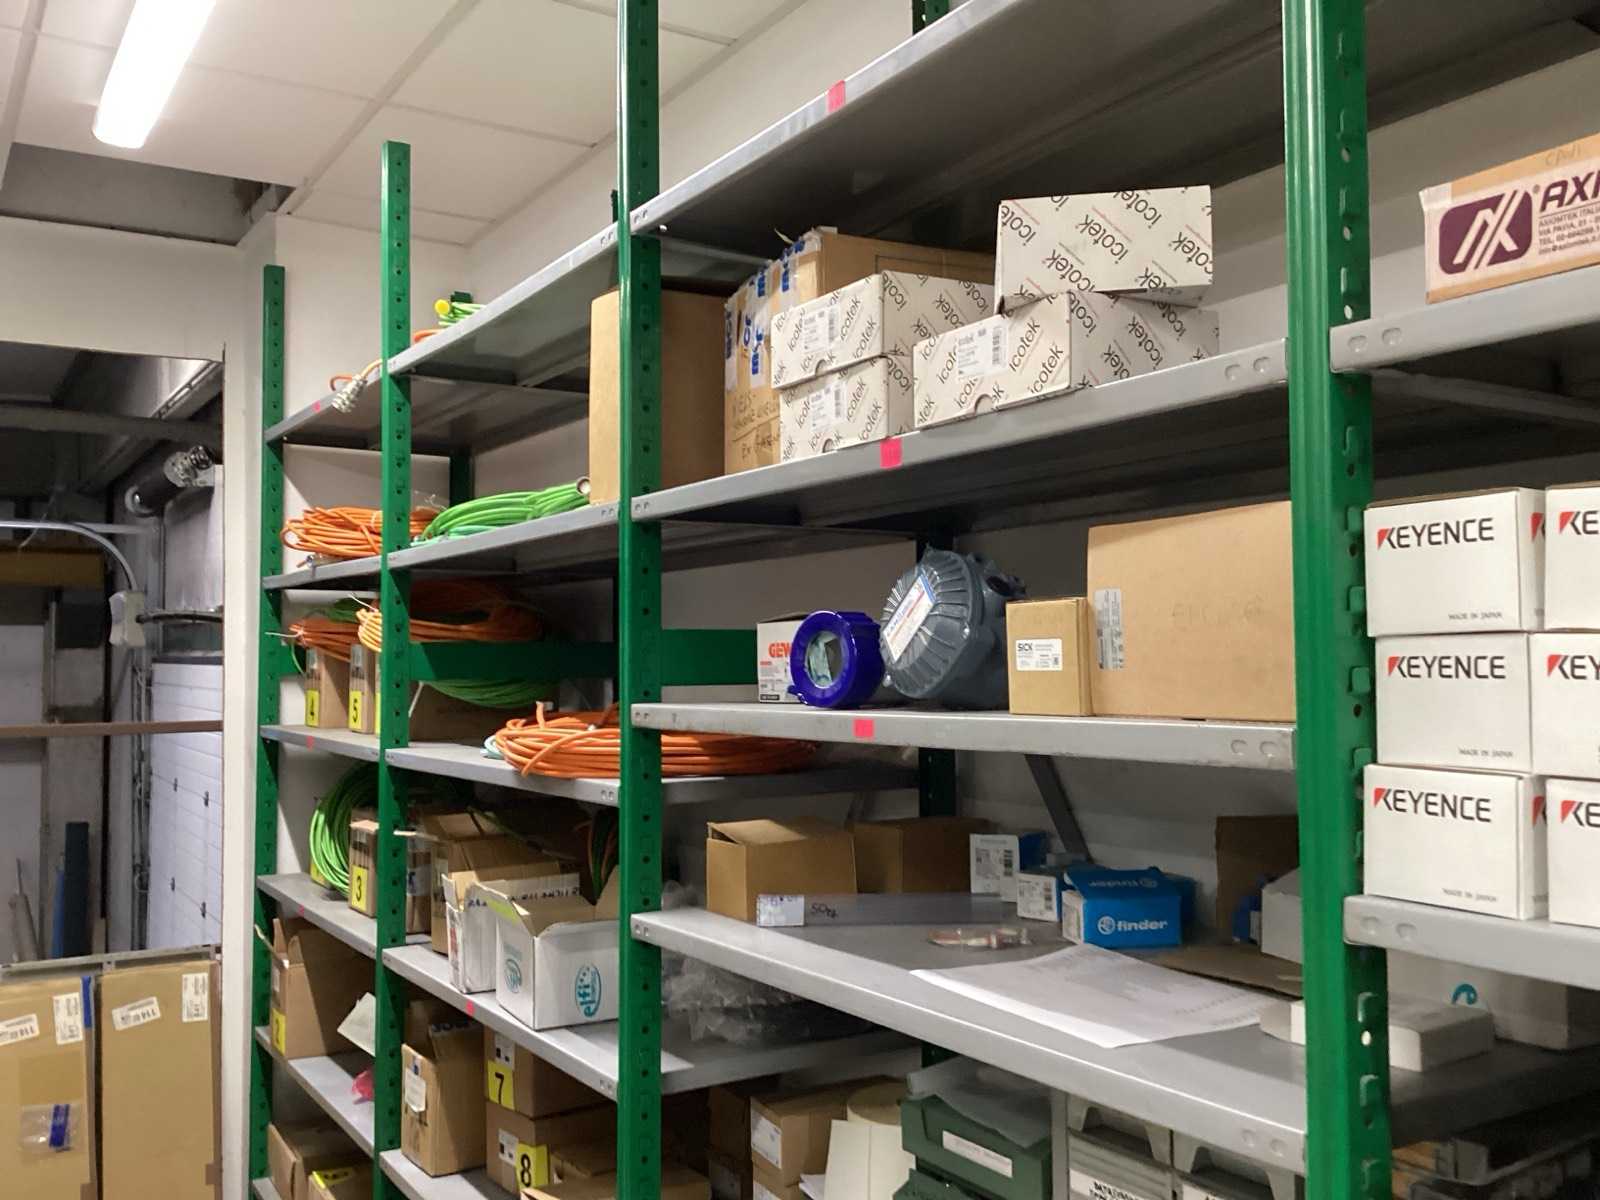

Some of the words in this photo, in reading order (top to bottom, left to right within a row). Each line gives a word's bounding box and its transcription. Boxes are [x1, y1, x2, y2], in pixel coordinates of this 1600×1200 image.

[1112, 190, 1163, 229] icote
[1074, 213, 1129, 265] icotek
[840, 295, 861, 342] icotek
[853, 316, 877, 359] icotek
[1008, 316, 1041, 372] icotek
[1127, 314, 1164, 371] icotek
[1027, 341, 1065, 394] icotek
[847, 376, 866, 423] icotek
[858, 397, 882, 441] icotek
[1378, 517, 1494, 550] KEYENCE
[1388, 655, 1506, 679] KEYENCE
[1374, 788, 1492, 822] KEYENCE
[355, 875, 362, 902] 3
[1117, 919, 1168, 932] finder
[494, 1071, 505, 1104] 7
[520, 1153, 531, 1188] 8
